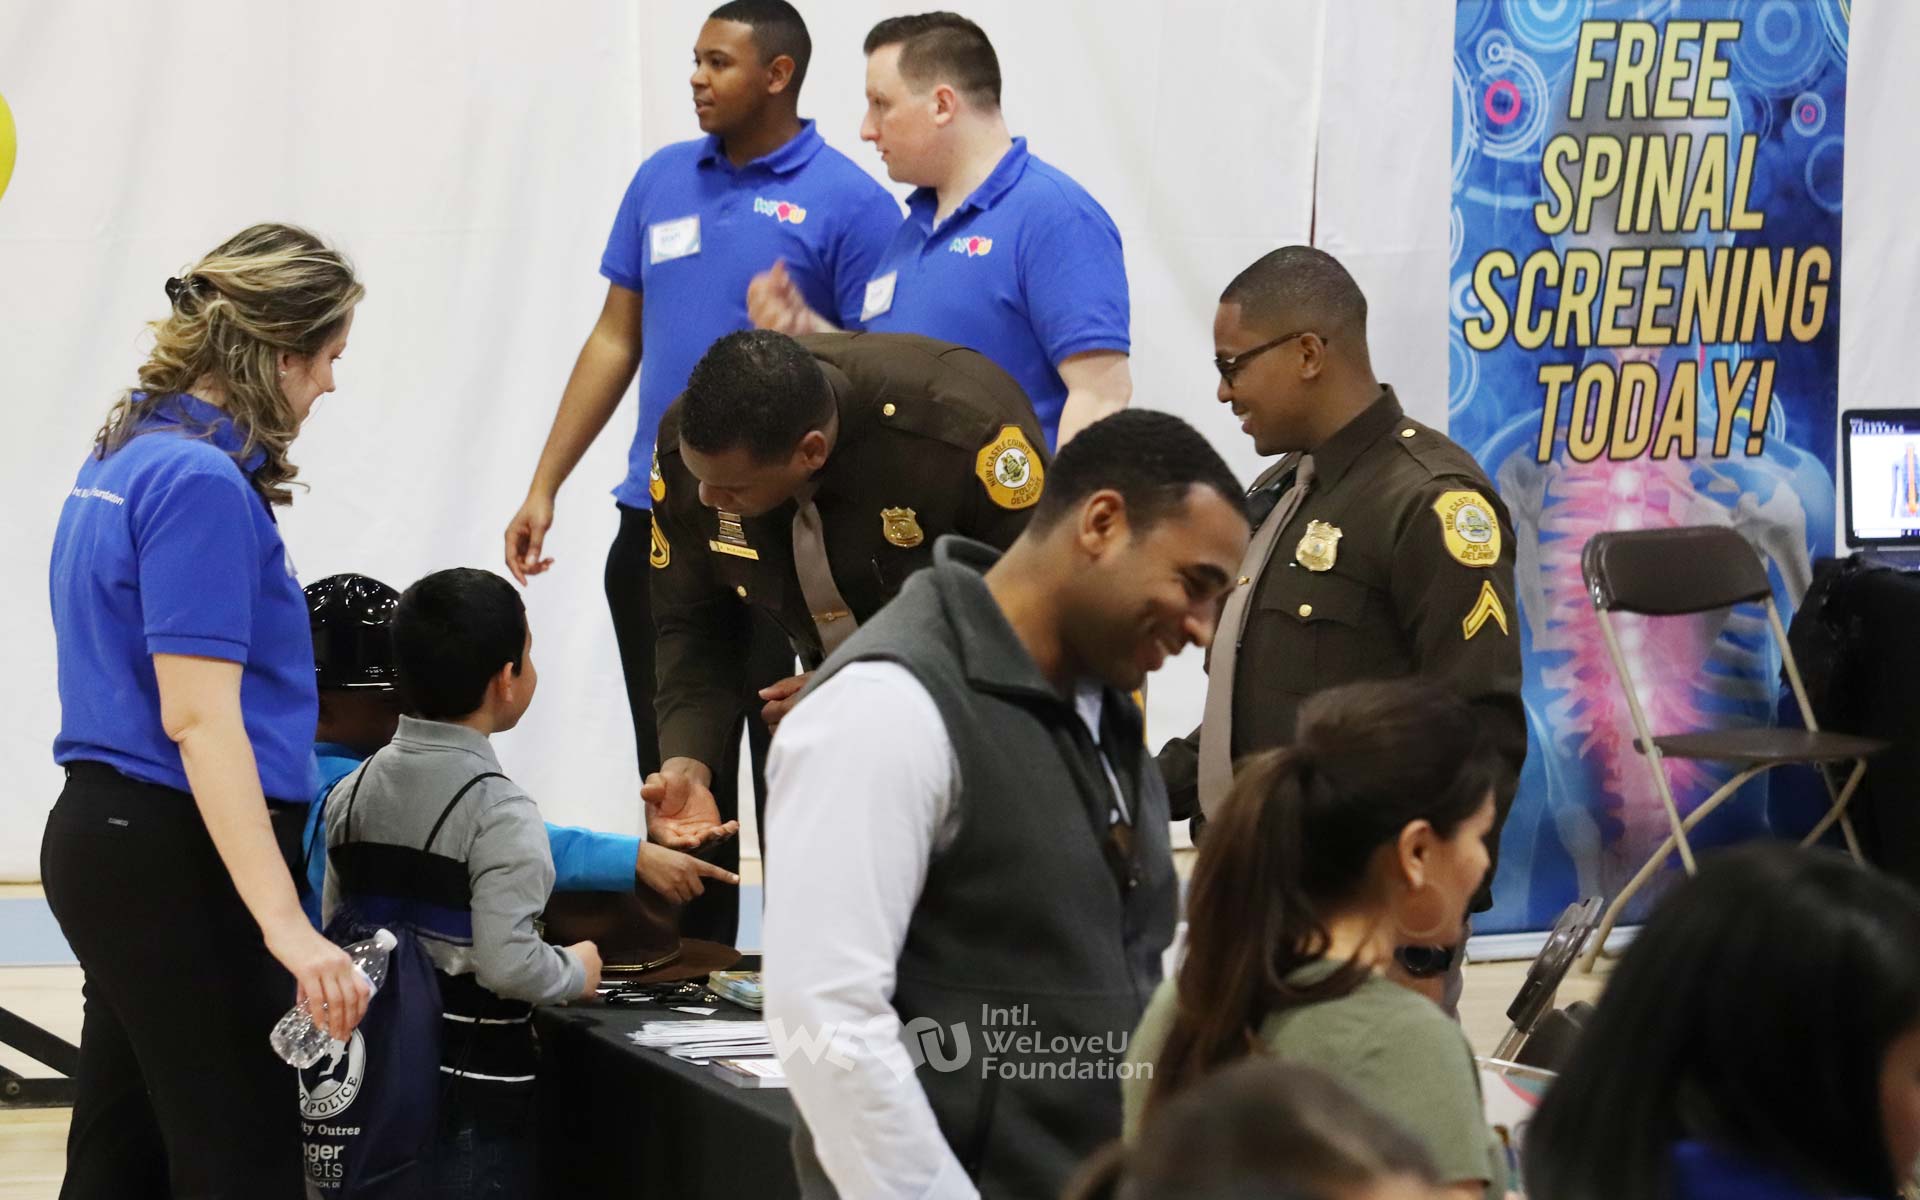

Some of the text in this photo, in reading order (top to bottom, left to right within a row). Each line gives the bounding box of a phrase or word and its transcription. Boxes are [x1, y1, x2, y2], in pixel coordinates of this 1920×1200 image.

[1567, 19, 1742, 120] FREE
[1533, 133, 1765, 236] SPINAL
[1462, 245, 1832, 351] SCREENING
[986, 441, 1007, 466] CASTLE
[1536, 359, 1777, 463] TODAY!
[986, 470, 997, 487] NEW
[309, 1076, 358, 1114] POLICE
